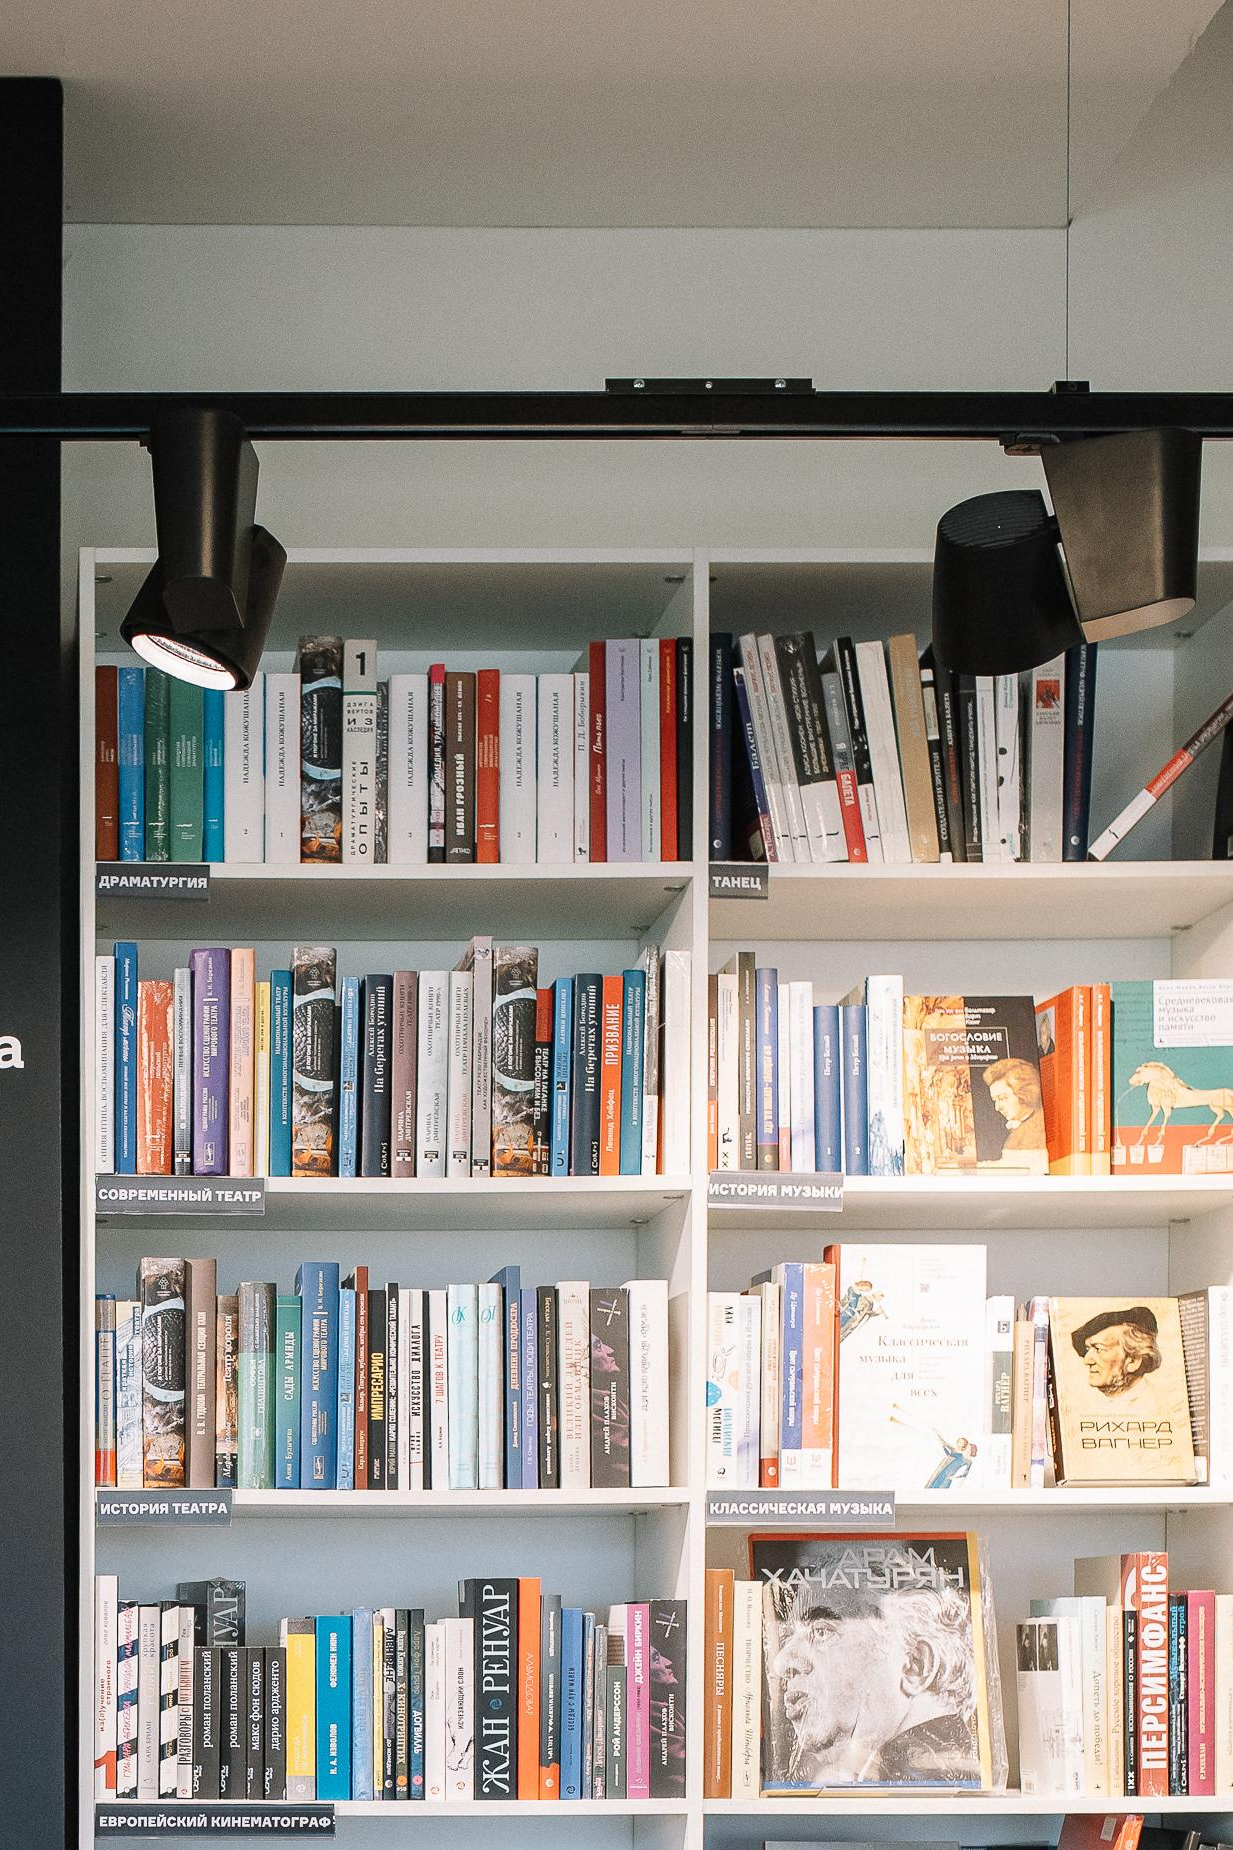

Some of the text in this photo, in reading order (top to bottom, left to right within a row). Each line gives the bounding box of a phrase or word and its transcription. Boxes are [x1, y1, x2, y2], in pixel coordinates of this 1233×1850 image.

[355, 651, 367, 676] 1
[454, 754, 464, 804] ГРОЗНЫЙ
[358, 761, 369, 855] ОПЫТЫ
[98, 875, 208, 889] ДРАМАТУРГИЯ
[712, 875, 762, 891] ТАНЕЦ
[374, 986, 386, 1092] На берегах утопий
[605, 1004, 619, 1065] ПРИЗВАНИЕ
[930, 1031, 1003, 1043] БОГОСЛОВИЕ
[943, 1045, 991, 1055] МУЗЫКА
[98, 1187, 262, 1202] СОВРЕМЕННЫЙ ТЕАТР
[708, 1183, 844, 1199] ИСТОРИЯ МУЗЫКИ
[878, 1335, 968, 1347] Классическая
[285, 1332, 295, 1400] САДЫ АРМИДЫ
[371, 1353, 384, 1420] ИМПРЕСАРИО
[1080, 1421, 1173, 1434] РИХАРД
[1082, 1438, 1173, 1450] ВАГНЕР
[100, 1502, 228, 1514] ИСТОРИЯ ТЕАТРА
[709, 1502, 893, 1515] КЛАССИЧЕСКАЯ МУЗЫКА
[761, 1567, 964, 1589] ХАЧАТУРЯН
[634, 1611, 644, 1683] ДЖЕЙН БИРКИН
[252, 1662, 261, 1696] сюдов
[1141, 1565, 1167, 1768] ПЕРСИМФАНС
[201, 1651, 212, 1748] роман поланский
[228, 1651, 240, 1748] роман поланский
[482, 1585, 510, 1793] ЖАН РЕНУАР
[251, 1699, 262, 1721] фон
[271, 1661, 281, 1750] дарио ардженто
[613, 1682, 622, 1736] АНДЕРССОН
[99, 1814, 332, 1828] ЕВРОПЕЙСКИЙ КИНЕМАТОГРАФ
